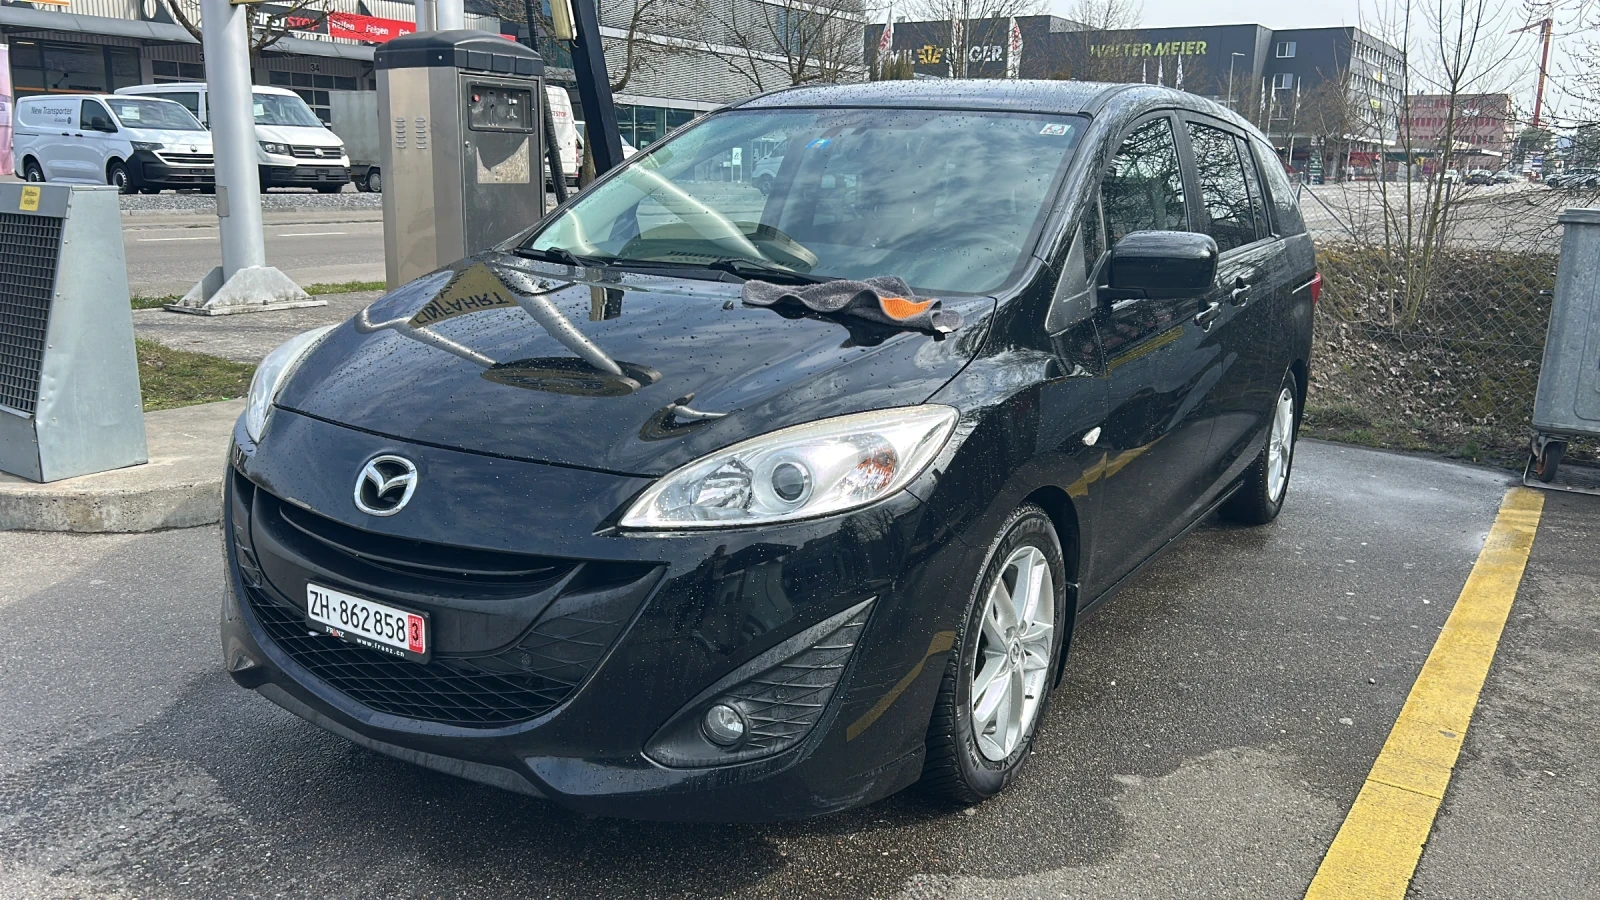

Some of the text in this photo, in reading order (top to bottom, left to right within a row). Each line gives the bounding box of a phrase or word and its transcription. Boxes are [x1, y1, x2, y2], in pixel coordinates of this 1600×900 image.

[253, 12, 287, 27] FIRST
[332, 20, 355, 30] Reifen
[366, 24, 389, 36] Felgen
[1090, 40, 1207, 58] WALTER MEIER
[310, 63, 320, 73] 34
[31, 106, 72, 117] New Transporter
[326, 625, 345, 638] FRANZ
[412, 622, 419, 642] 3
